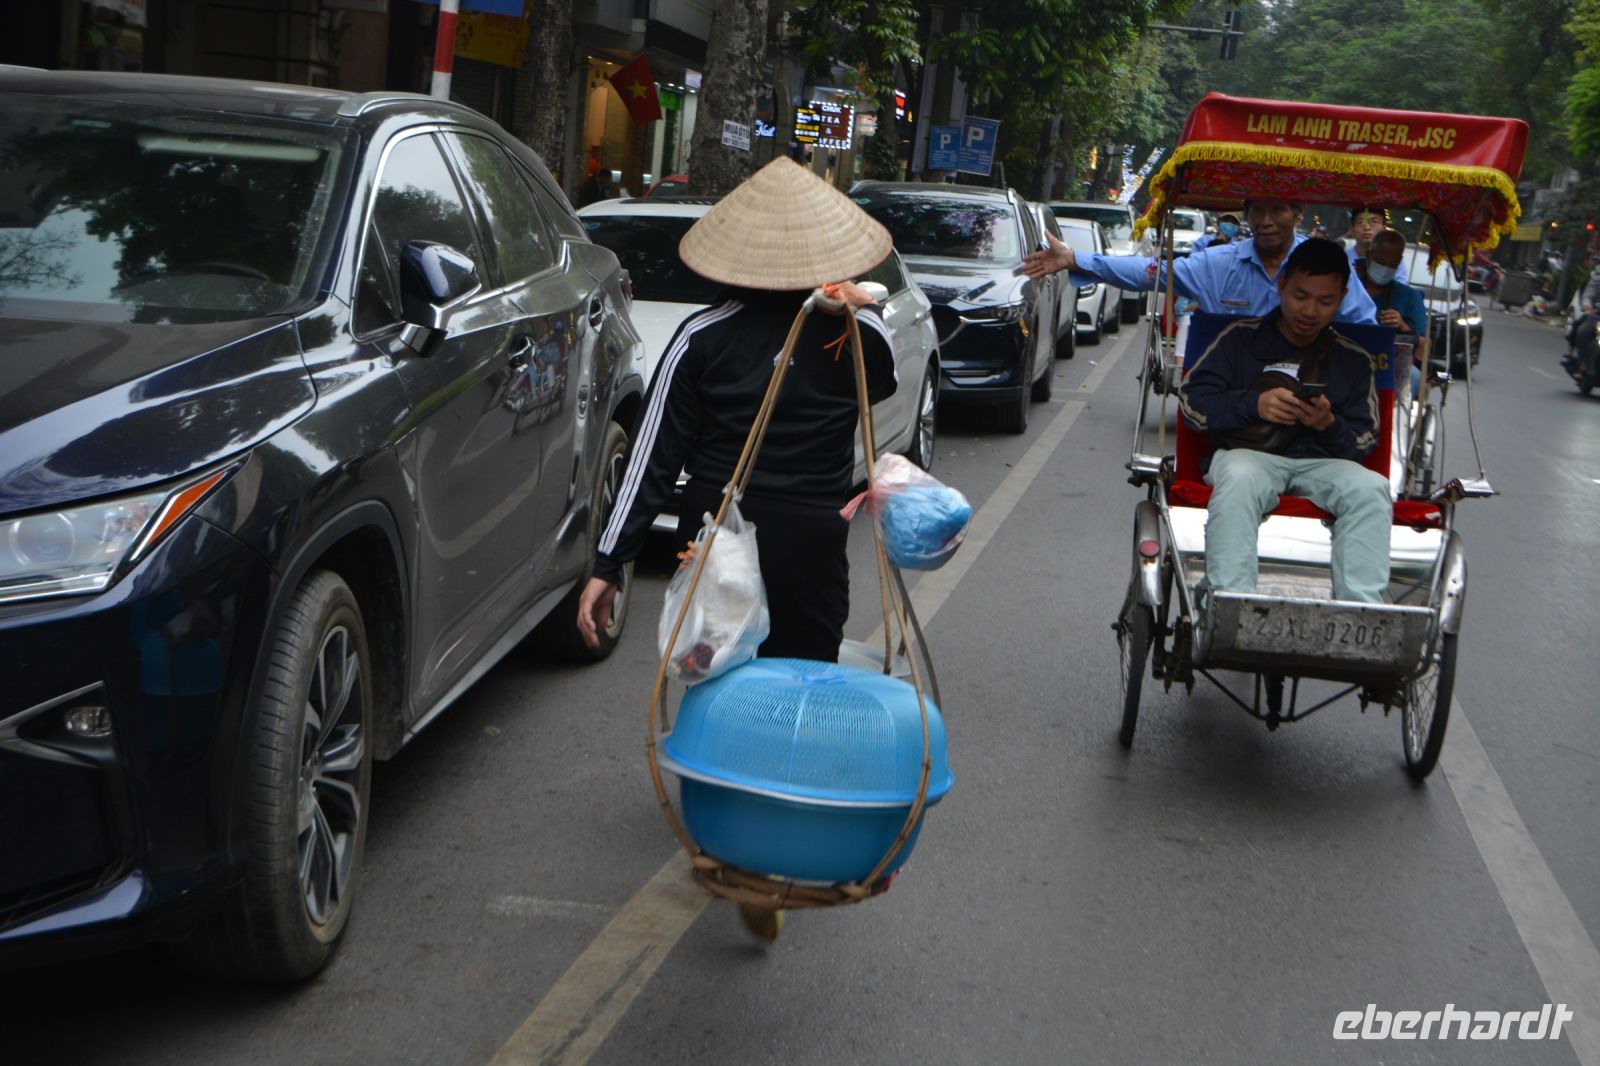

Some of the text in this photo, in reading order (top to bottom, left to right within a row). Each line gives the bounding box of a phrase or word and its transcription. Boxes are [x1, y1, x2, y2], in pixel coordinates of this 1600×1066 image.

[821, 115, 840, 124] TEA
[1247, 113, 1288, 134] LAM
[1291, 116, 1333, 139] ANH
[940, 133, 951, 150] P
[966, 126, 985, 147] P
